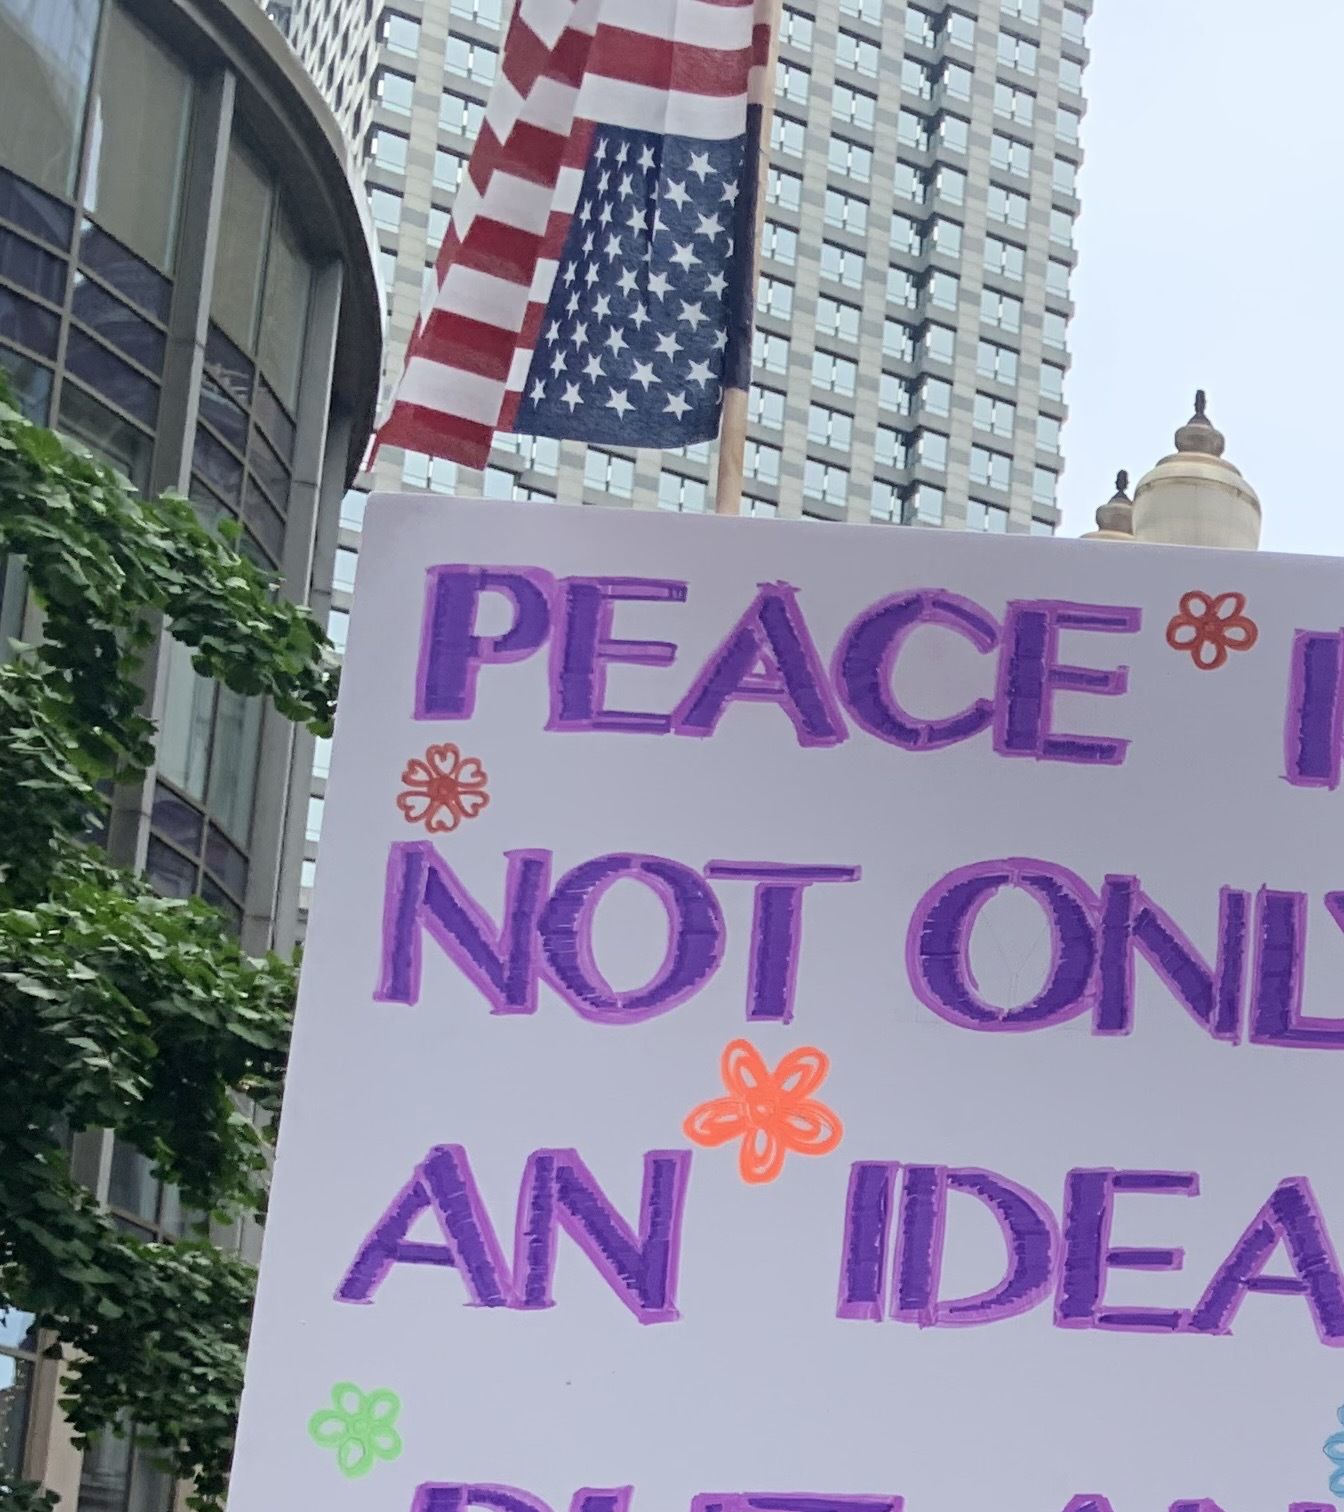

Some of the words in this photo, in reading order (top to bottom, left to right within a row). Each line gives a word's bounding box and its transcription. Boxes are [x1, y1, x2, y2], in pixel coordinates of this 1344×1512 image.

[411, 563, 1143, 766] PEACE
[373, 840, 863, 1026] NOT
[334, 1142, 694, 1325] AN
